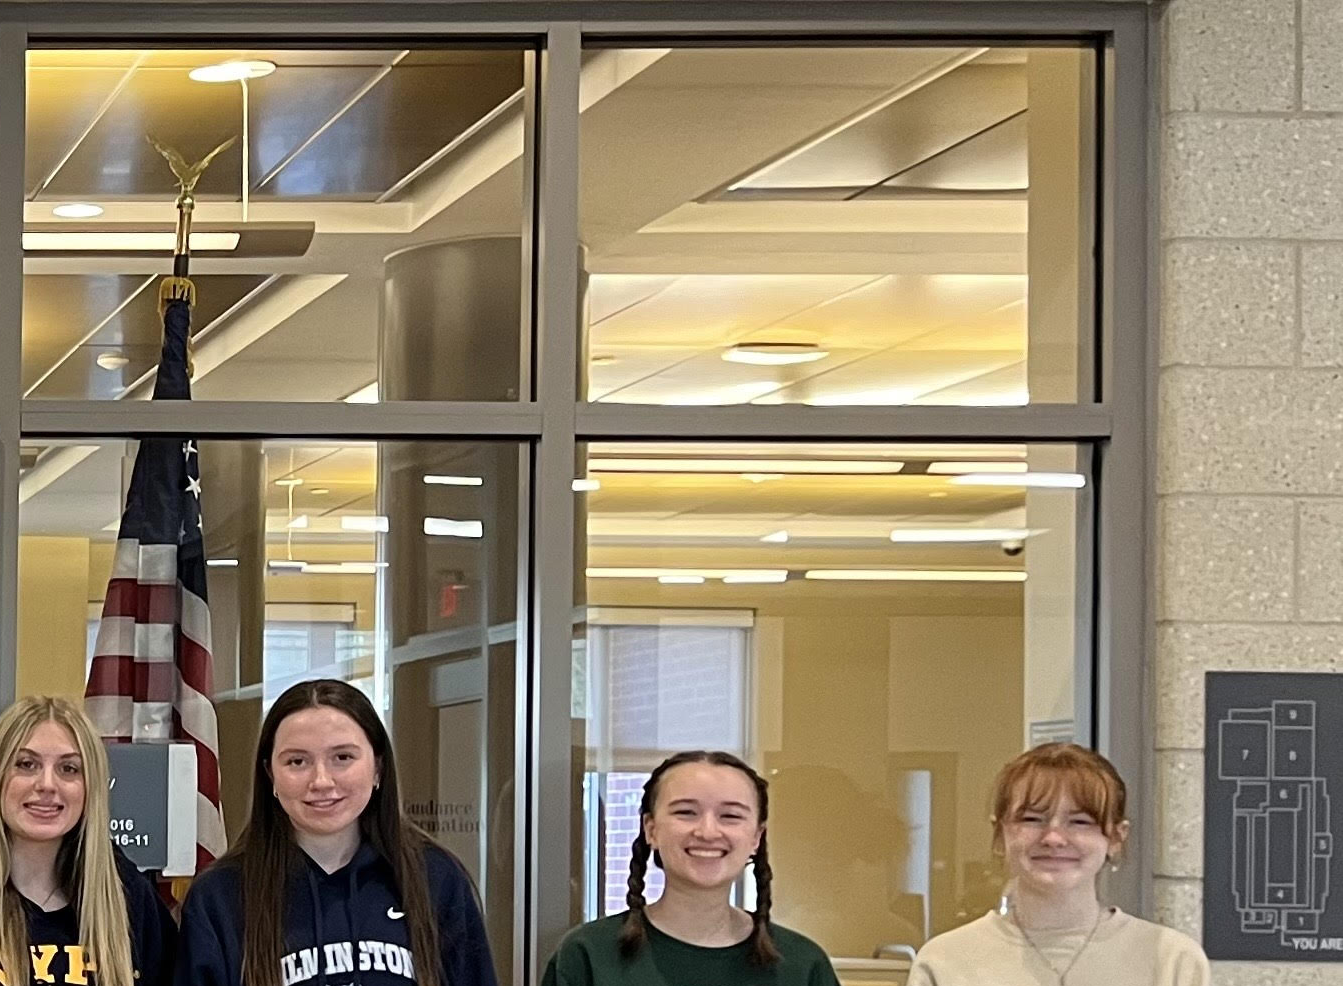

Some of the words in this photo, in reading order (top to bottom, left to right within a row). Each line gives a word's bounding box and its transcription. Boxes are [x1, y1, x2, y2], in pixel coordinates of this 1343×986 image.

[1242, 749, 1249, 760] 7
[1276, 888, 1285, 900] 4
[1292, 937, 1318, 950] YOU
